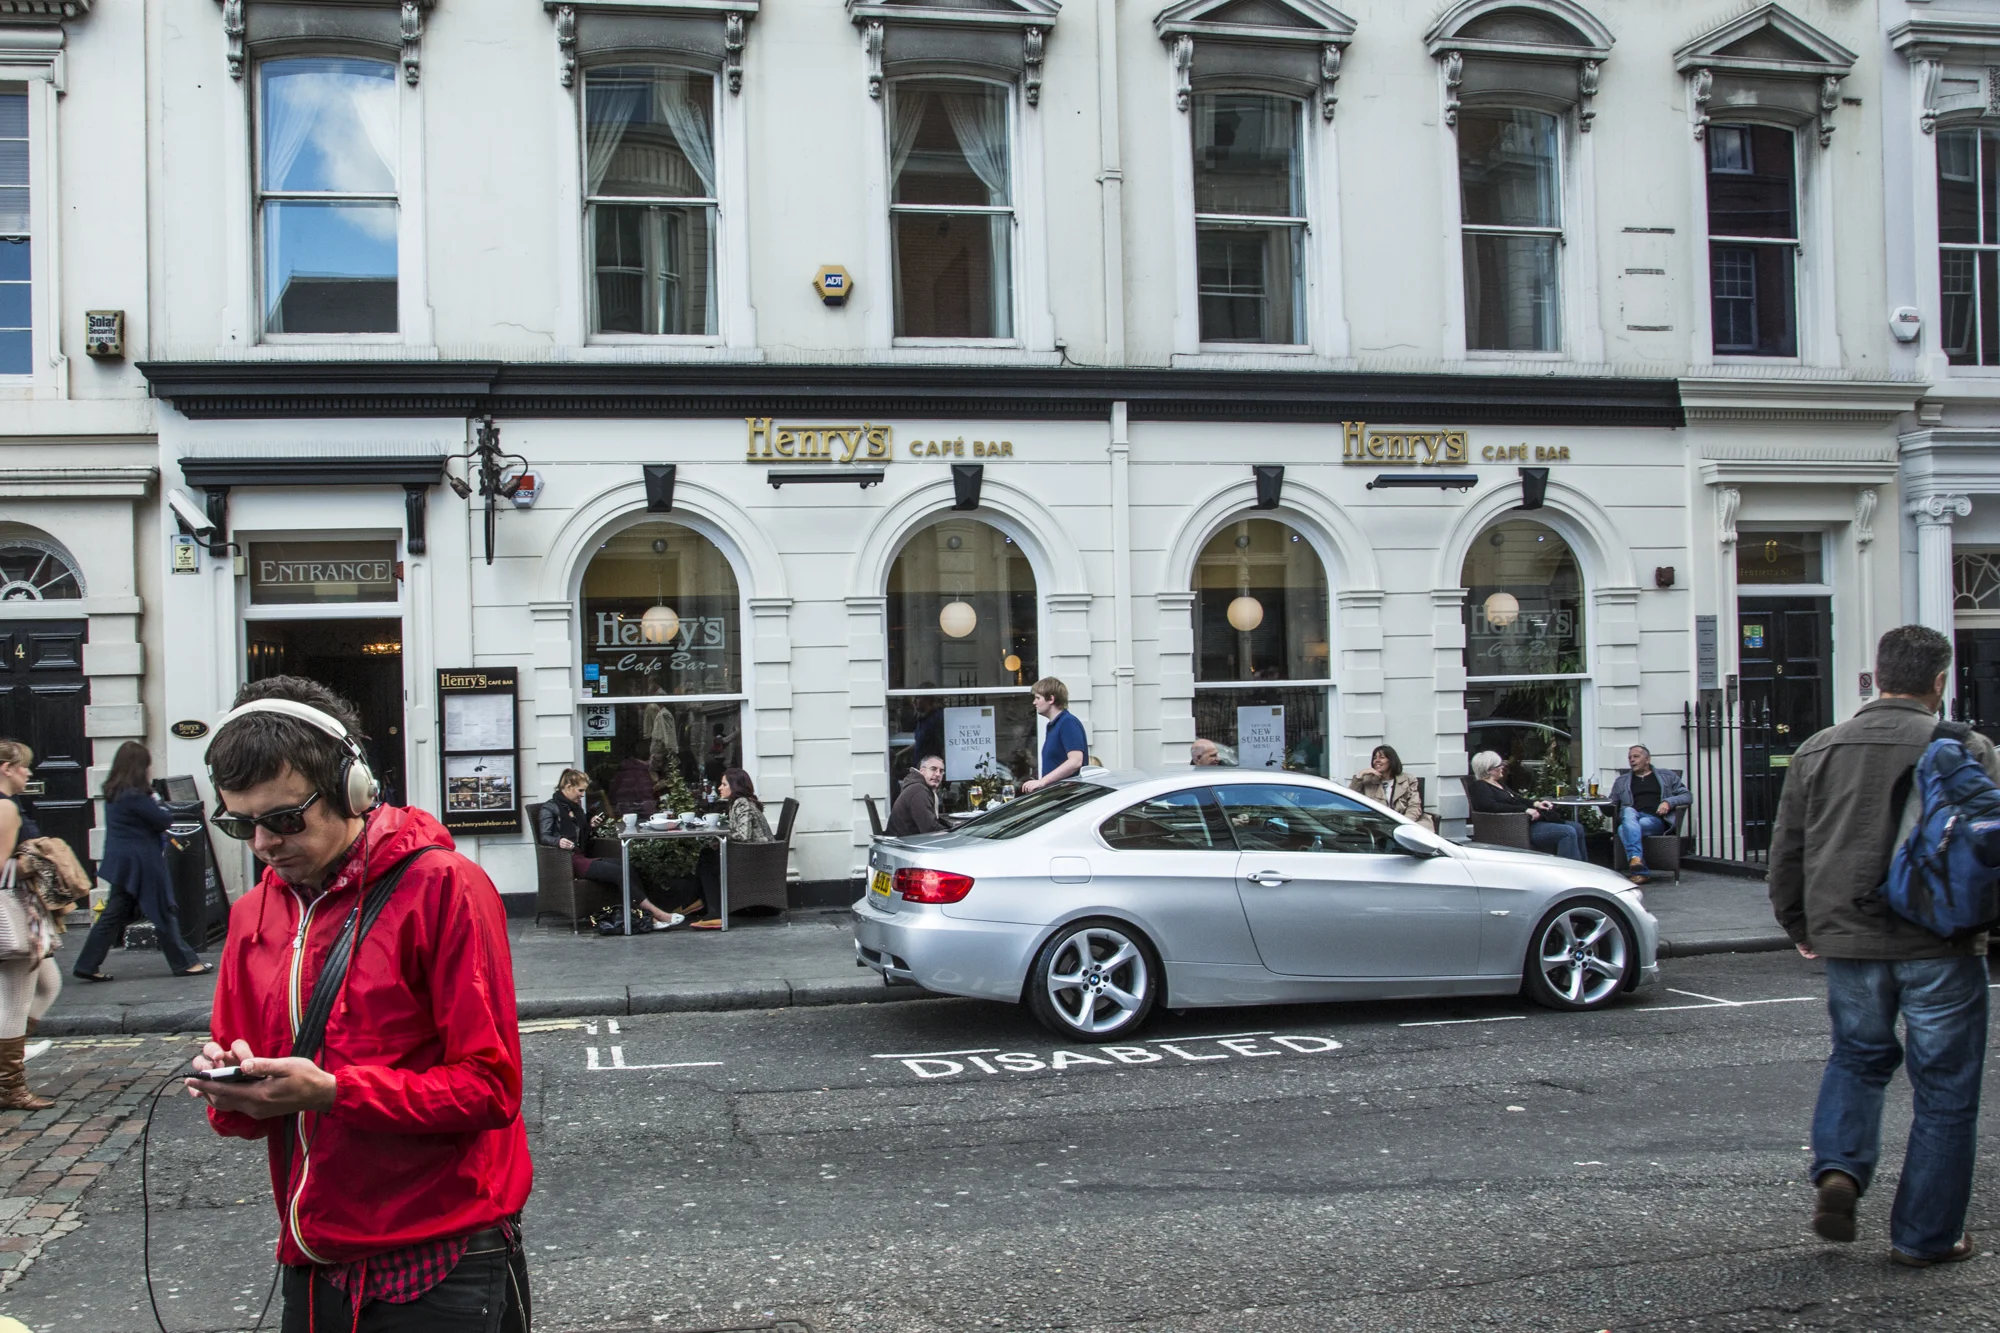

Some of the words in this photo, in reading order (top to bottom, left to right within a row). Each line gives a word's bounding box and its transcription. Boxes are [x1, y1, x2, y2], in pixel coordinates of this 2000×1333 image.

[825, 276, 843, 285] ADT
[89, 316, 116, 328] Solar
[89, 328, 117, 336] Security
[745, 417, 888, 462] Henry's
[909, 436, 965, 457] CAFÉ
[972, 440, 1014, 457] BAR
[1341, 421, 1464, 465] Henry's
[1482, 442, 1529, 460] CAFÉ
[1536, 445, 1571, 460] BAR
[260, 560, 388, 582] ENTRANCE
[1470, 604, 1570, 639] Henry's
[596, 612, 722, 651] Henry's
[15, 643, 26, 659] 4
[617, 653, 662, 675] Cafe
[670, 652, 707, 671] Bar
[1776, 664, 1783, 674] 6
[441, 674, 486, 689] Henry's
[587, 706, 610, 714] FREE
[948, 738, 992, 746] SUMMER
[1241, 735, 1281, 744] SUMMER
[447, 820, 517, 828] www.henryscafebar.co.uk
[900, 1035, 1344, 1079] DISABLED
